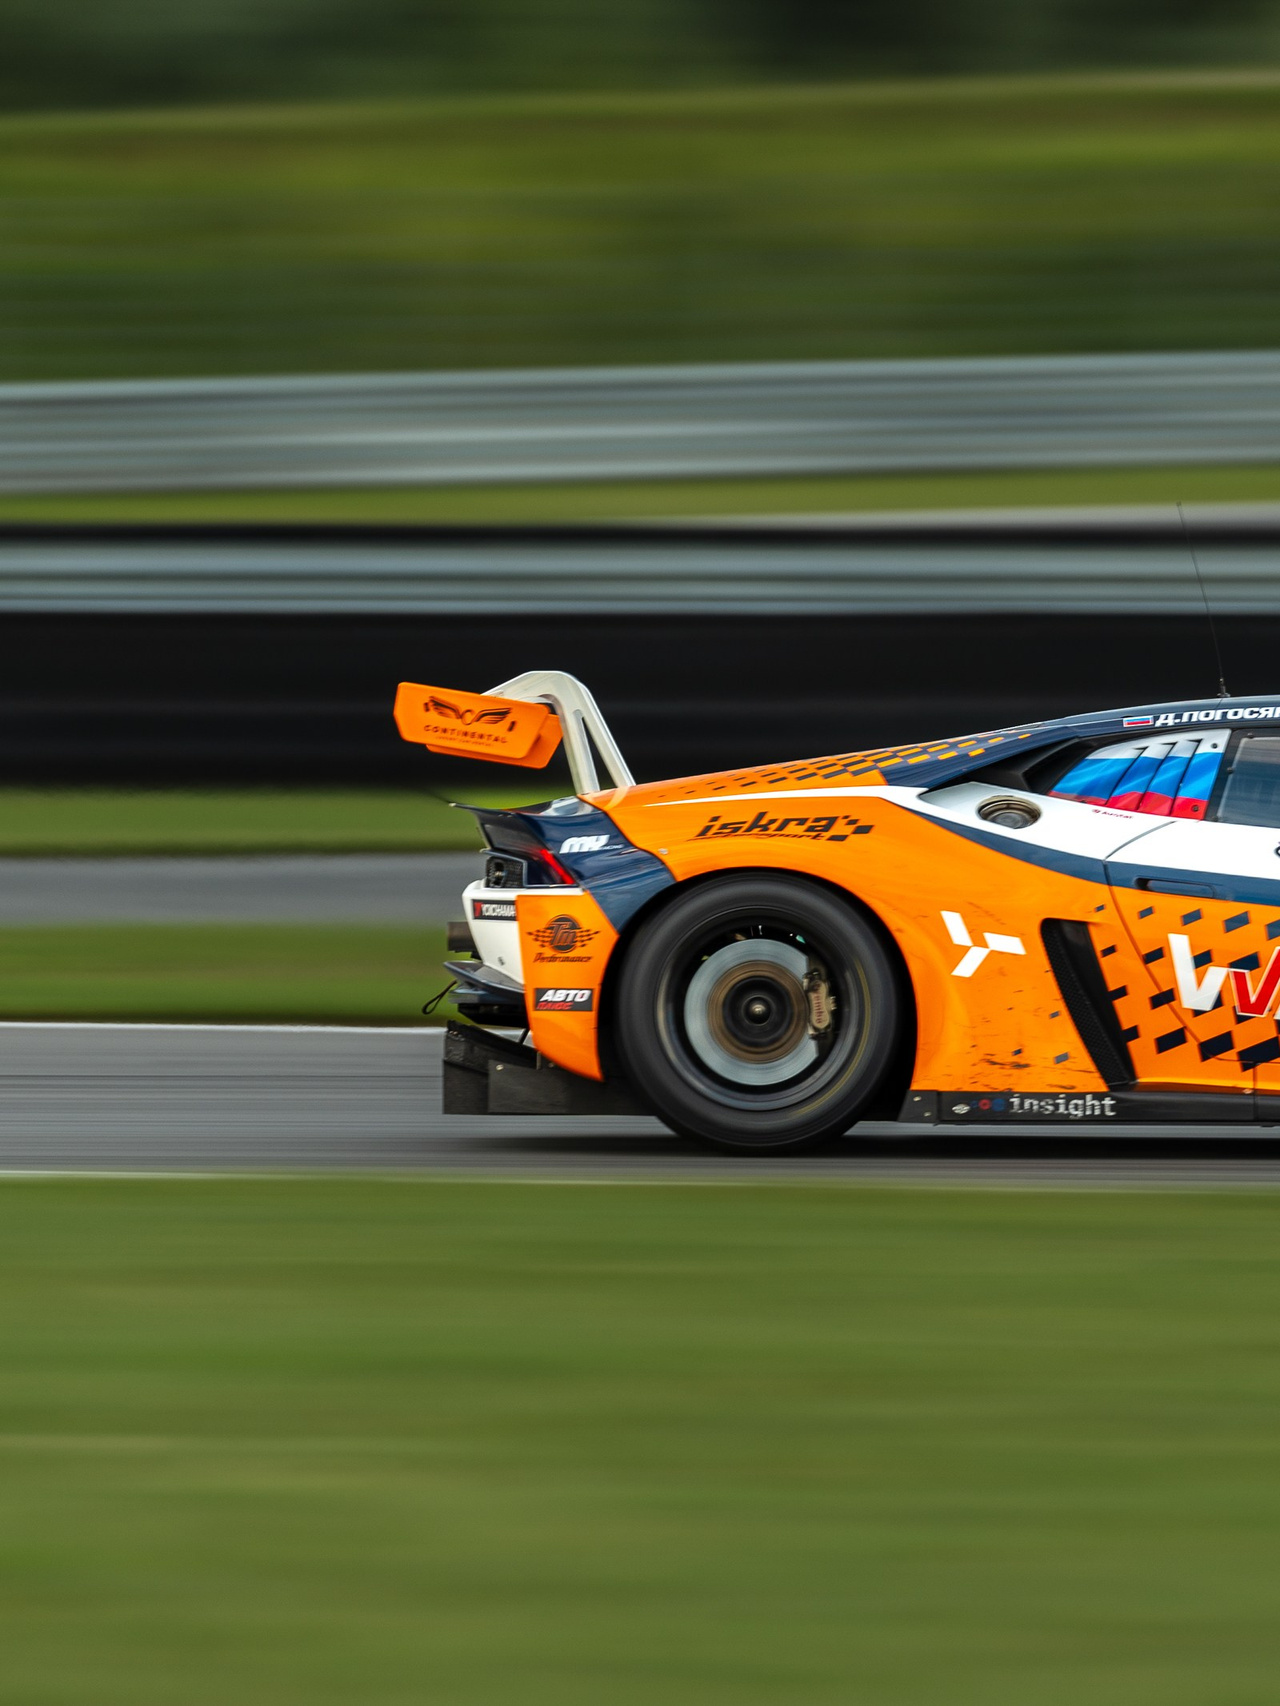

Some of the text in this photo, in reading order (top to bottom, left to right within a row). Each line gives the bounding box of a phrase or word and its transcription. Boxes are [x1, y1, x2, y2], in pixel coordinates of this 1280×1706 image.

[695, 811, 841, 838] iskra
[539, 989, 592, 1002] АВТО
[1009, 1093, 1117, 1119] insight
